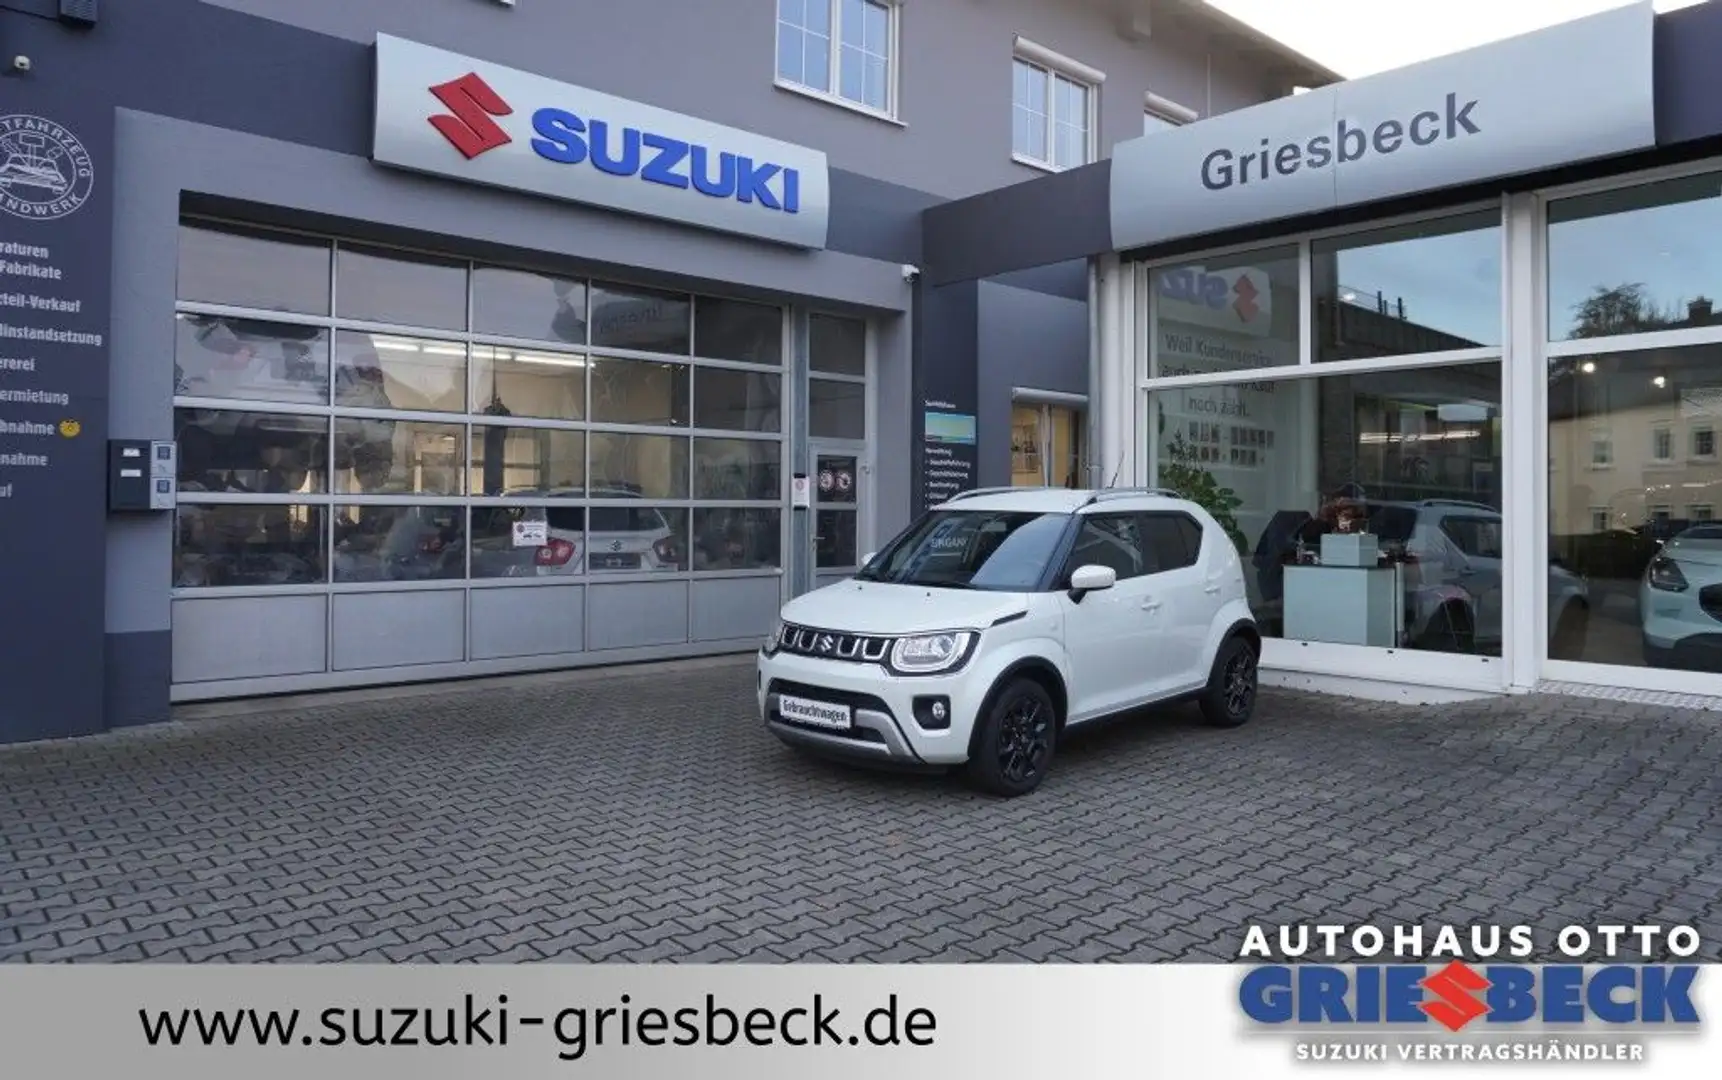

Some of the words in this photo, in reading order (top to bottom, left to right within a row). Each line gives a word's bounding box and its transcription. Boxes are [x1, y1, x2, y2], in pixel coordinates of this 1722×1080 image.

[531, 107, 799, 214] SUZUKI
[1200, 92, 1482, 191] Griesbeck
[0, 259, 62, 280] Fabrikate
